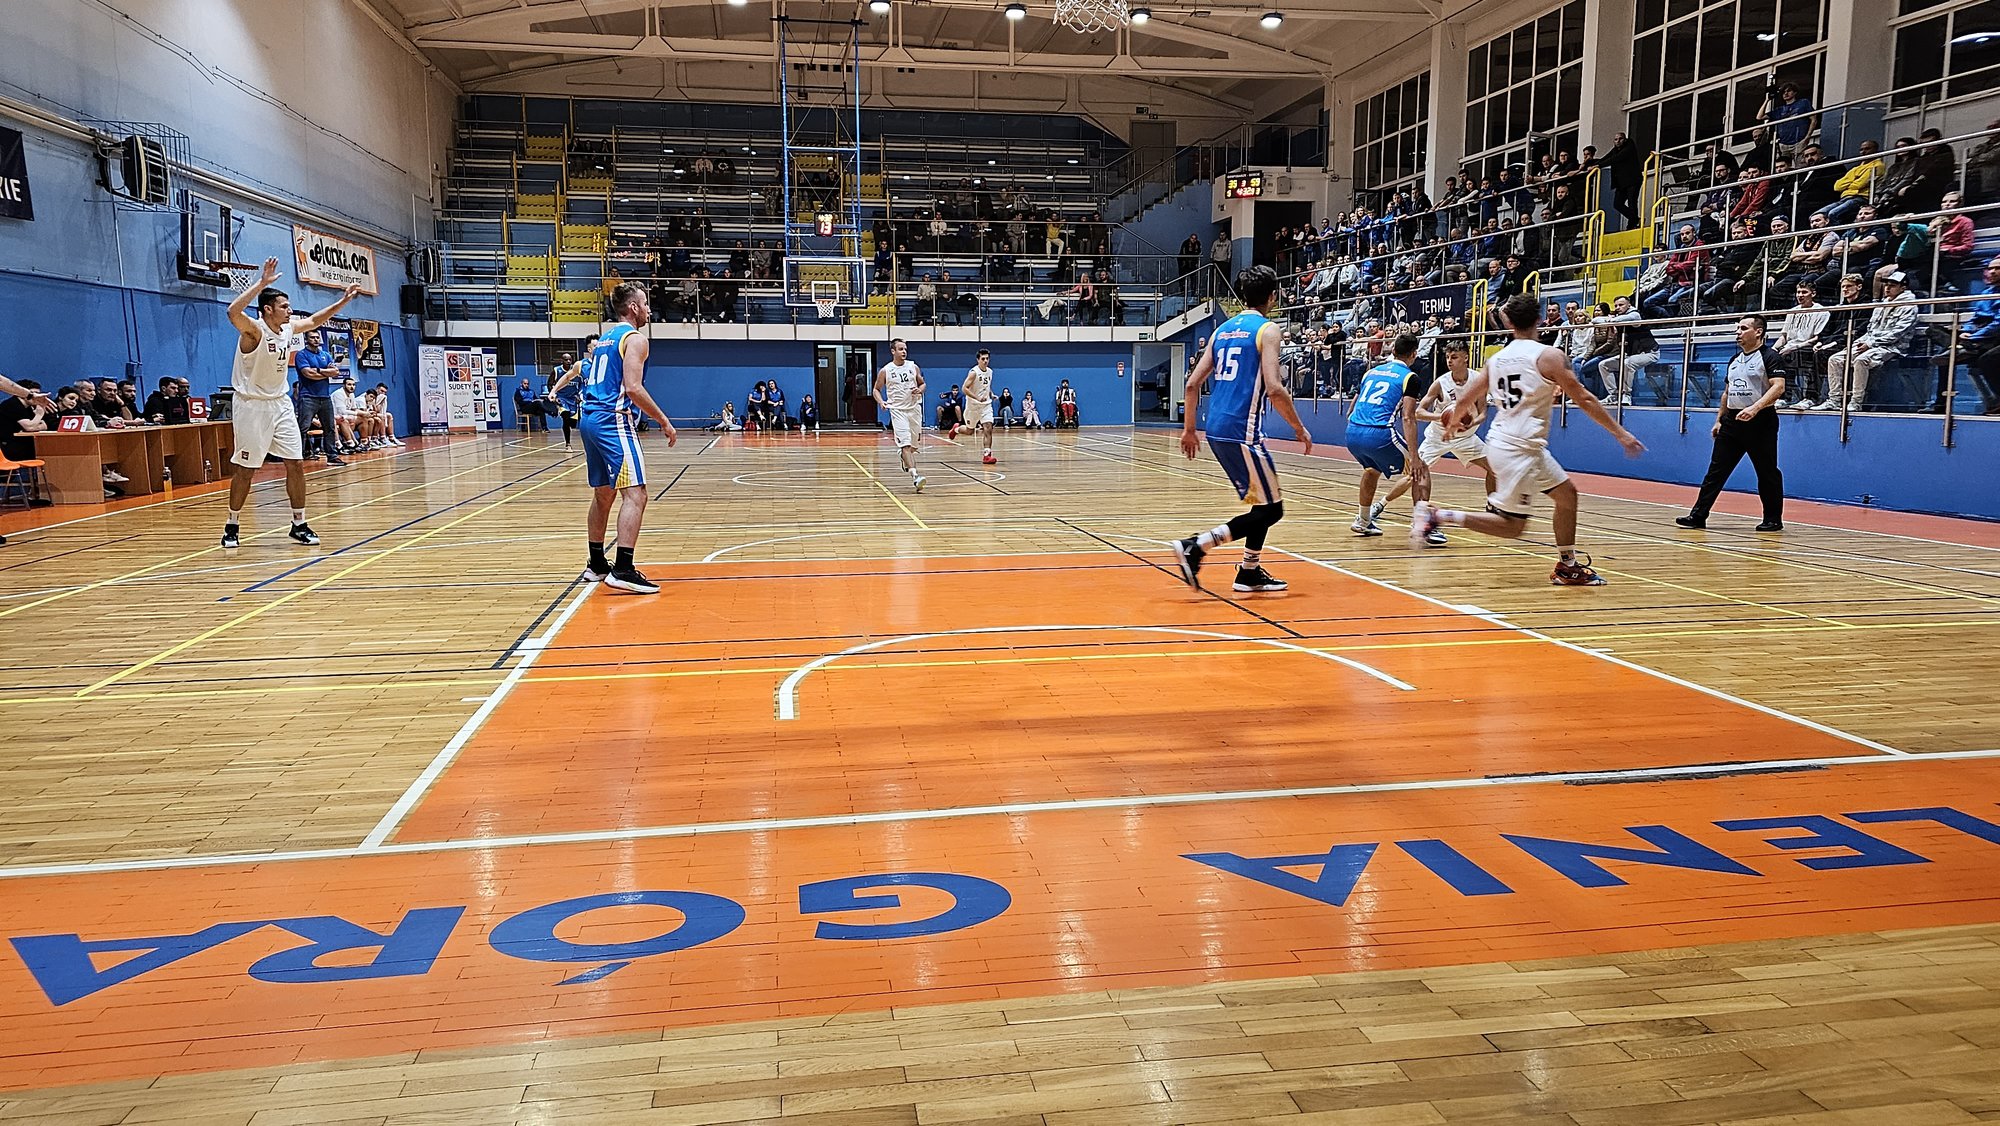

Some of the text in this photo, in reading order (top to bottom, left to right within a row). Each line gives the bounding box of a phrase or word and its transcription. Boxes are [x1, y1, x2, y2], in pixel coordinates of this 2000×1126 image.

[1420, 297, 1452, 314] TERMY
[588, 353, 609, 386] 10
[1214, 347, 1242, 381] 15
[899, 372, 909, 382] 12
[1359, 379, 1390, 405] 12
[191, 402, 204, 415] 5
[62, 417, 80, 430] 5
[9, 871, 1012, 1007] GÓRA
